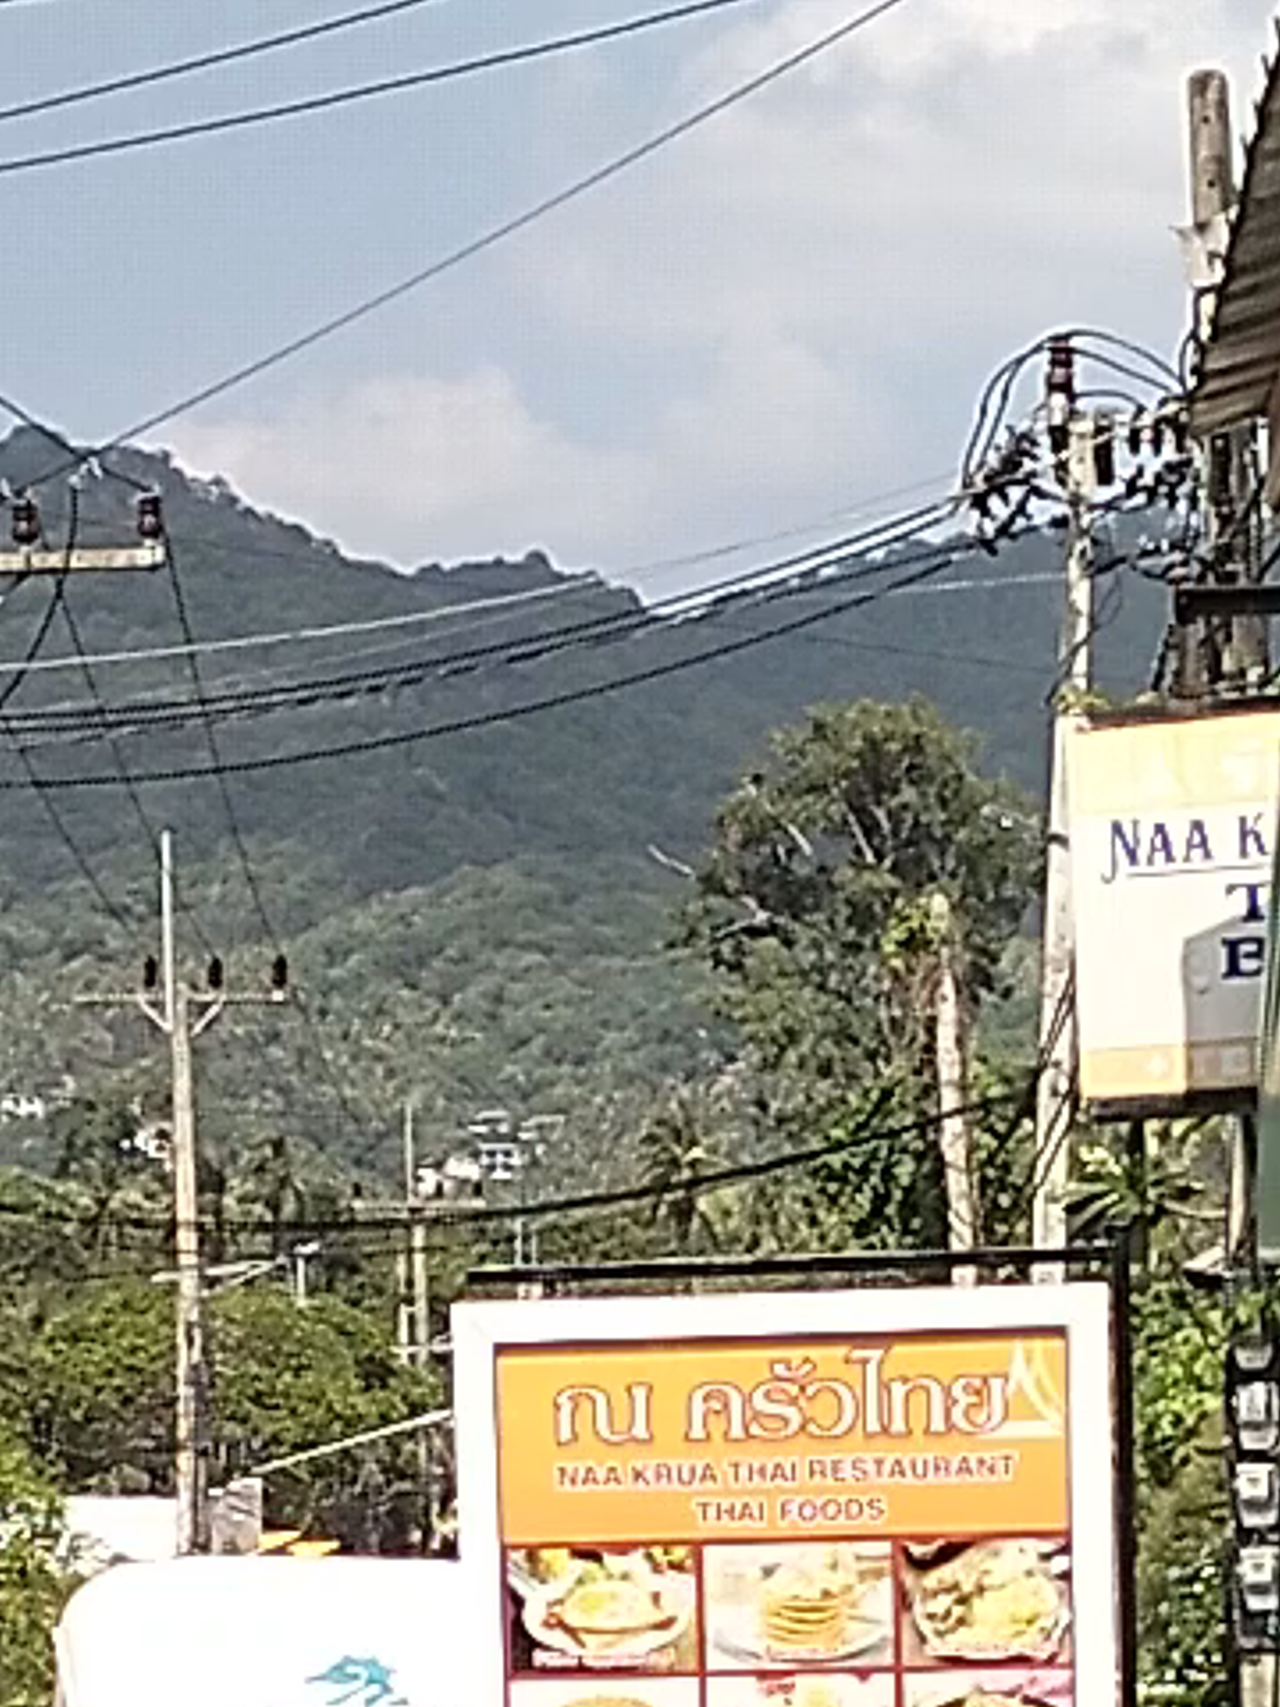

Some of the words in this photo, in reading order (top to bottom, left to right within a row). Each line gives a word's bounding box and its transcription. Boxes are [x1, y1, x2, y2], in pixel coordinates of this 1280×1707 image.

[1101, 817, 1213, 884] NAA
[553, 1383, 653, 1446] ณ
[685, 1346, 1010, 1443] ครัวไทย
[557, 1462, 622, 1488] NAA
[631, 1459, 719, 1487] KRUA
[728, 1459, 799, 1485] THAI
[808, 1454, 1014, 1483] RESTAURANT
[695, 1500, 766, 1524] THAI
[778, 1496, 887, 1522] FOODS
